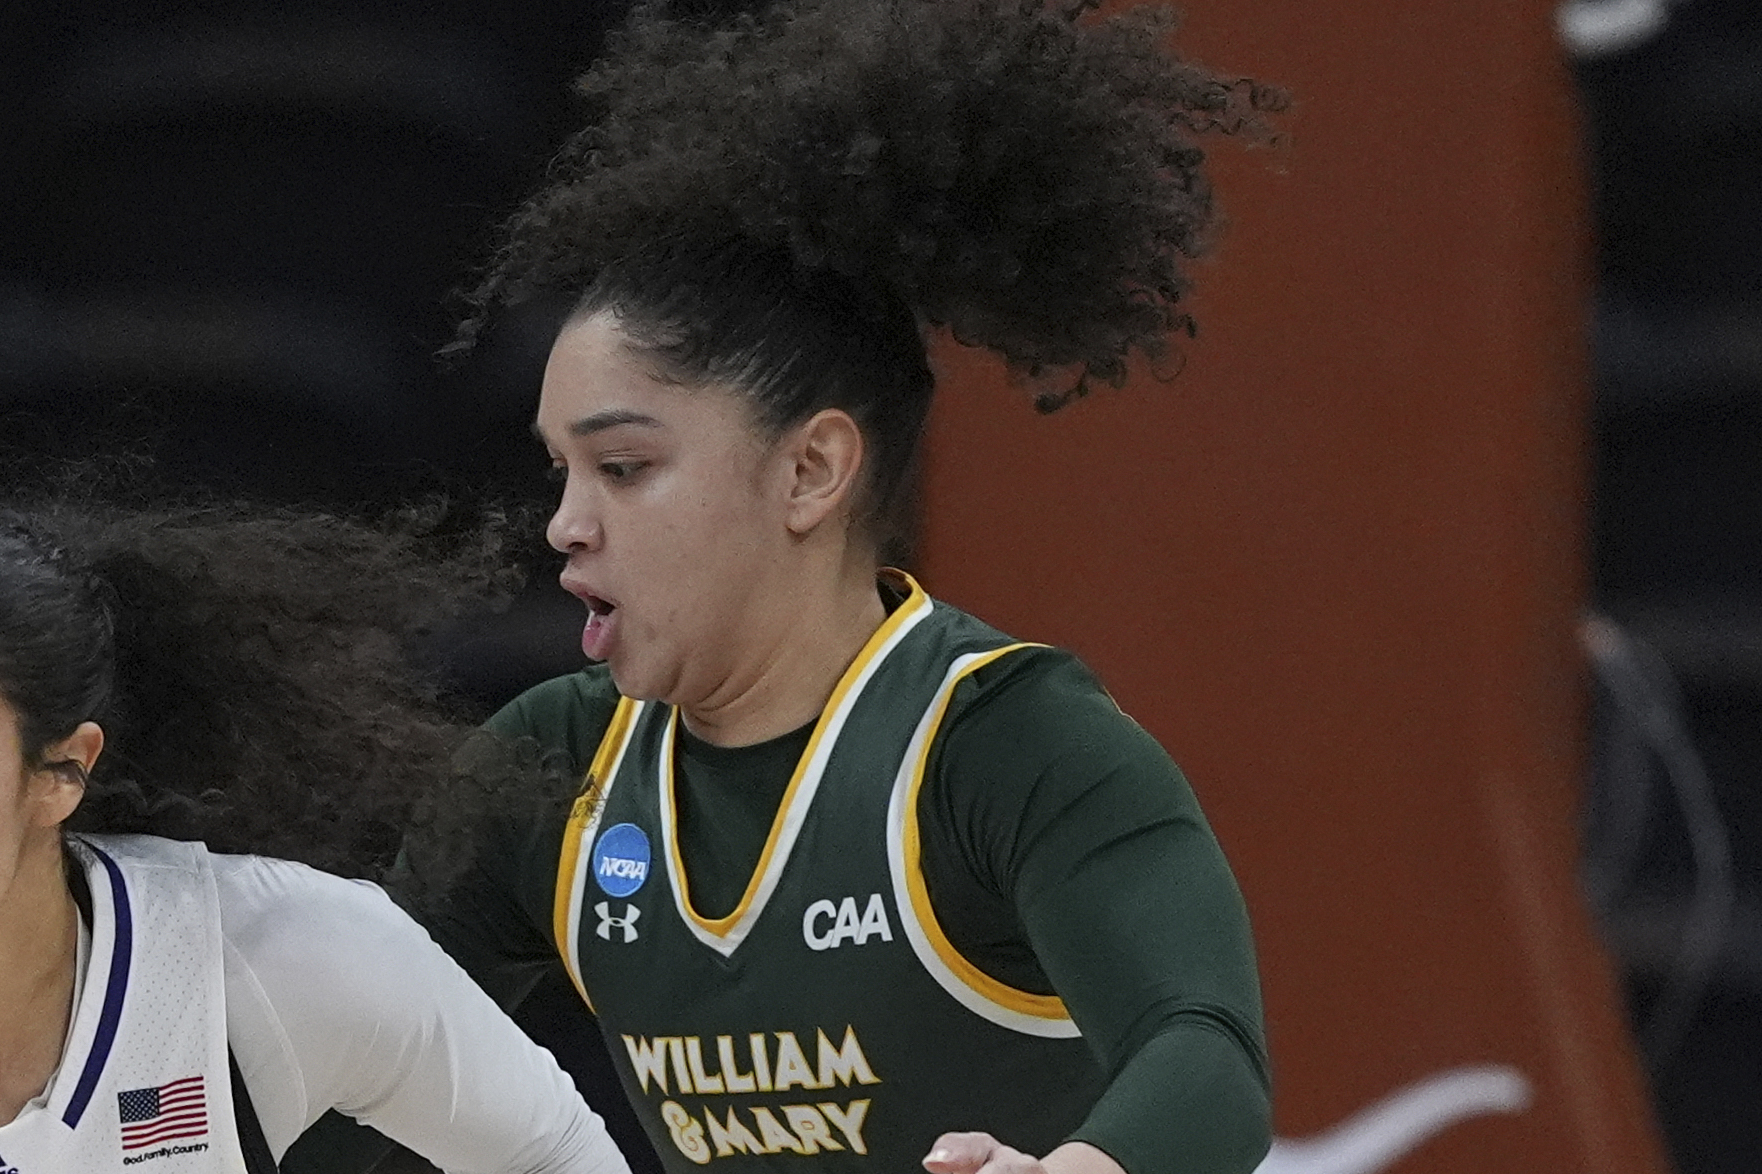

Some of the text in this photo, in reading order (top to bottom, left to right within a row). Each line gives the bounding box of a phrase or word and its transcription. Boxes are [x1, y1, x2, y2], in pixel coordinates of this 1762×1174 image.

[599, 856, 647, 880] NCAA
[803, 893, 894, 951] CAA
[621, 1023, 882, 1096] WILLIAM
[661, 1098, 871, 1165] &MARY
